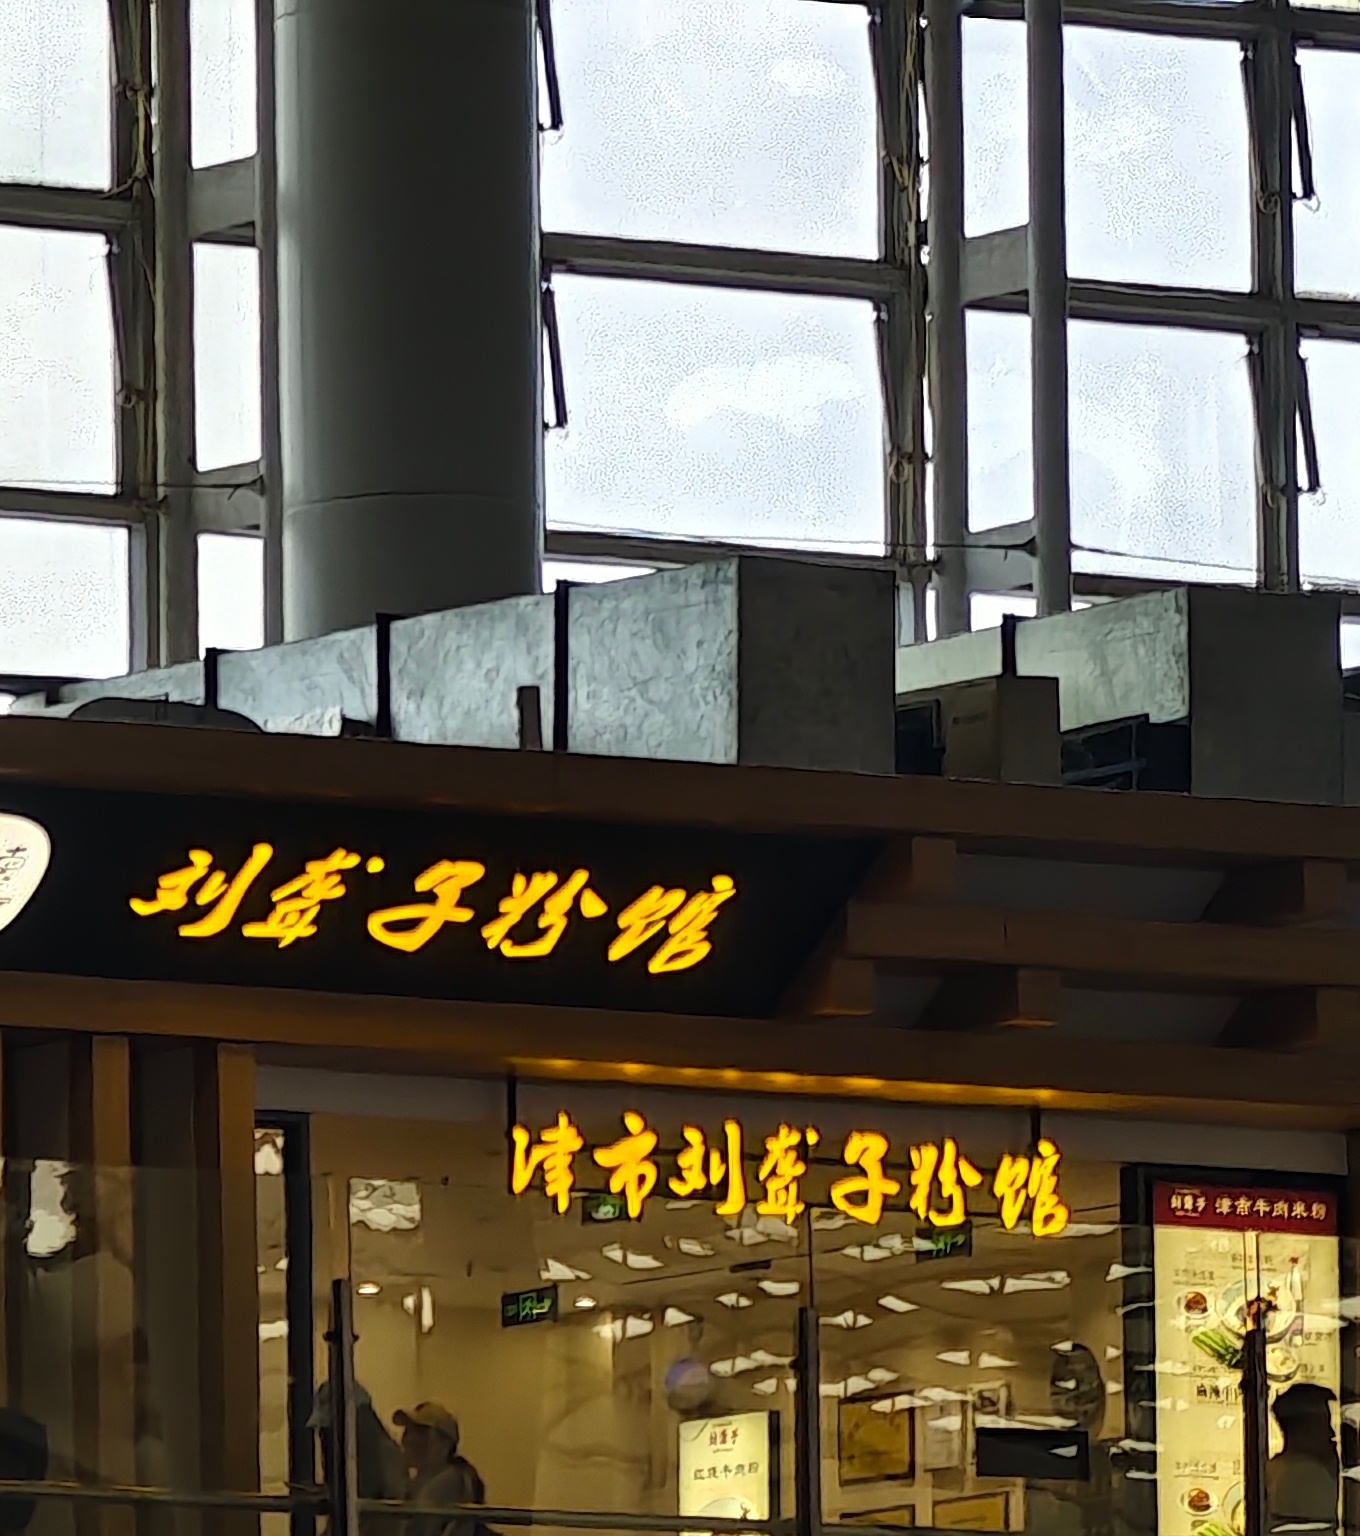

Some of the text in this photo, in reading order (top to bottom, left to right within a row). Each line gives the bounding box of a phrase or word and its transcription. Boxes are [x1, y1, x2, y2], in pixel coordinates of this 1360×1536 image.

[511, 1110, 1071, 1238] 津市刘聋子粉馆
